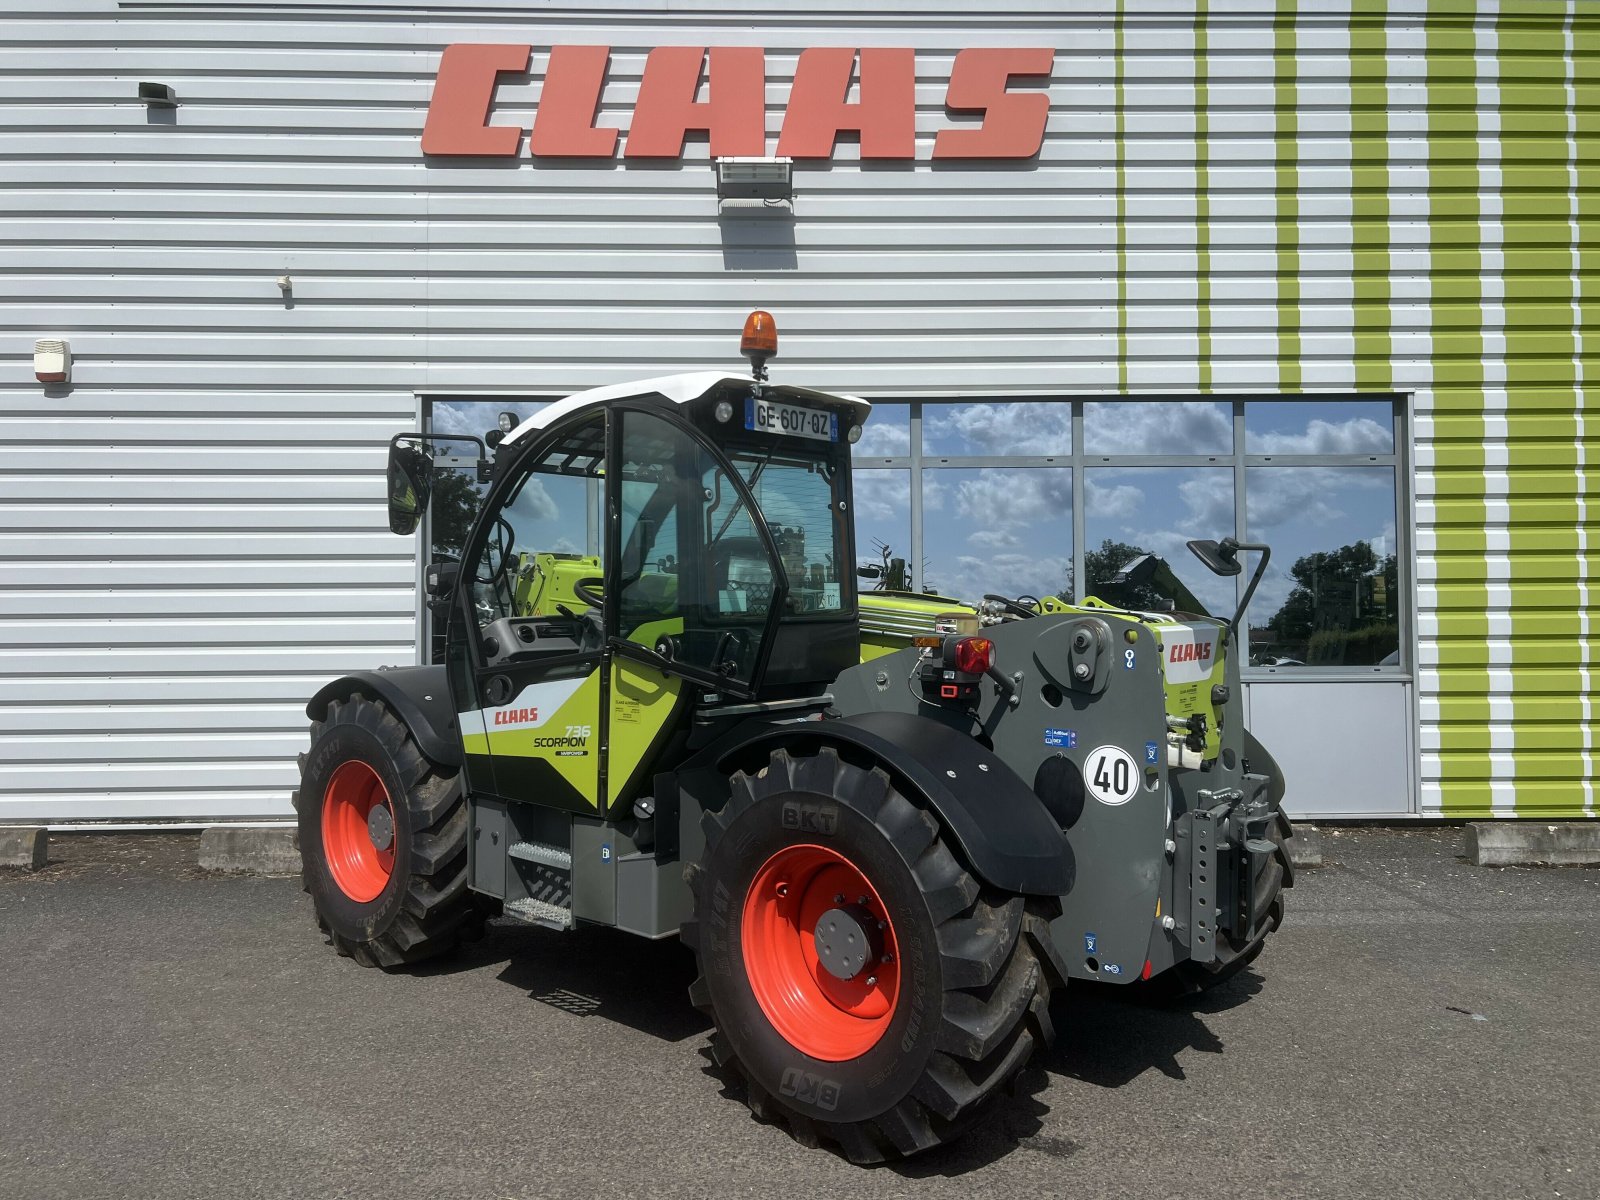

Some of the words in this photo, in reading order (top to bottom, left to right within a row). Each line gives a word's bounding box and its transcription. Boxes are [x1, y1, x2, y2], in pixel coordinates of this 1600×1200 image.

[421, 43, 1056, 158] CLAAS
[756, 404, 829, 436] GE-607-QZ
[1169, 642, 1211, 663] CLAAS
[494, 707, 538, 725] CLAAS
[565, 725, 592, 738] 736
[533, 737, 586, 748] SCORPION
[1093, 756, 1129, 796] 40
[781, 802, 838, 836] BKT
[778, 1067, 842, 1111] BKT
